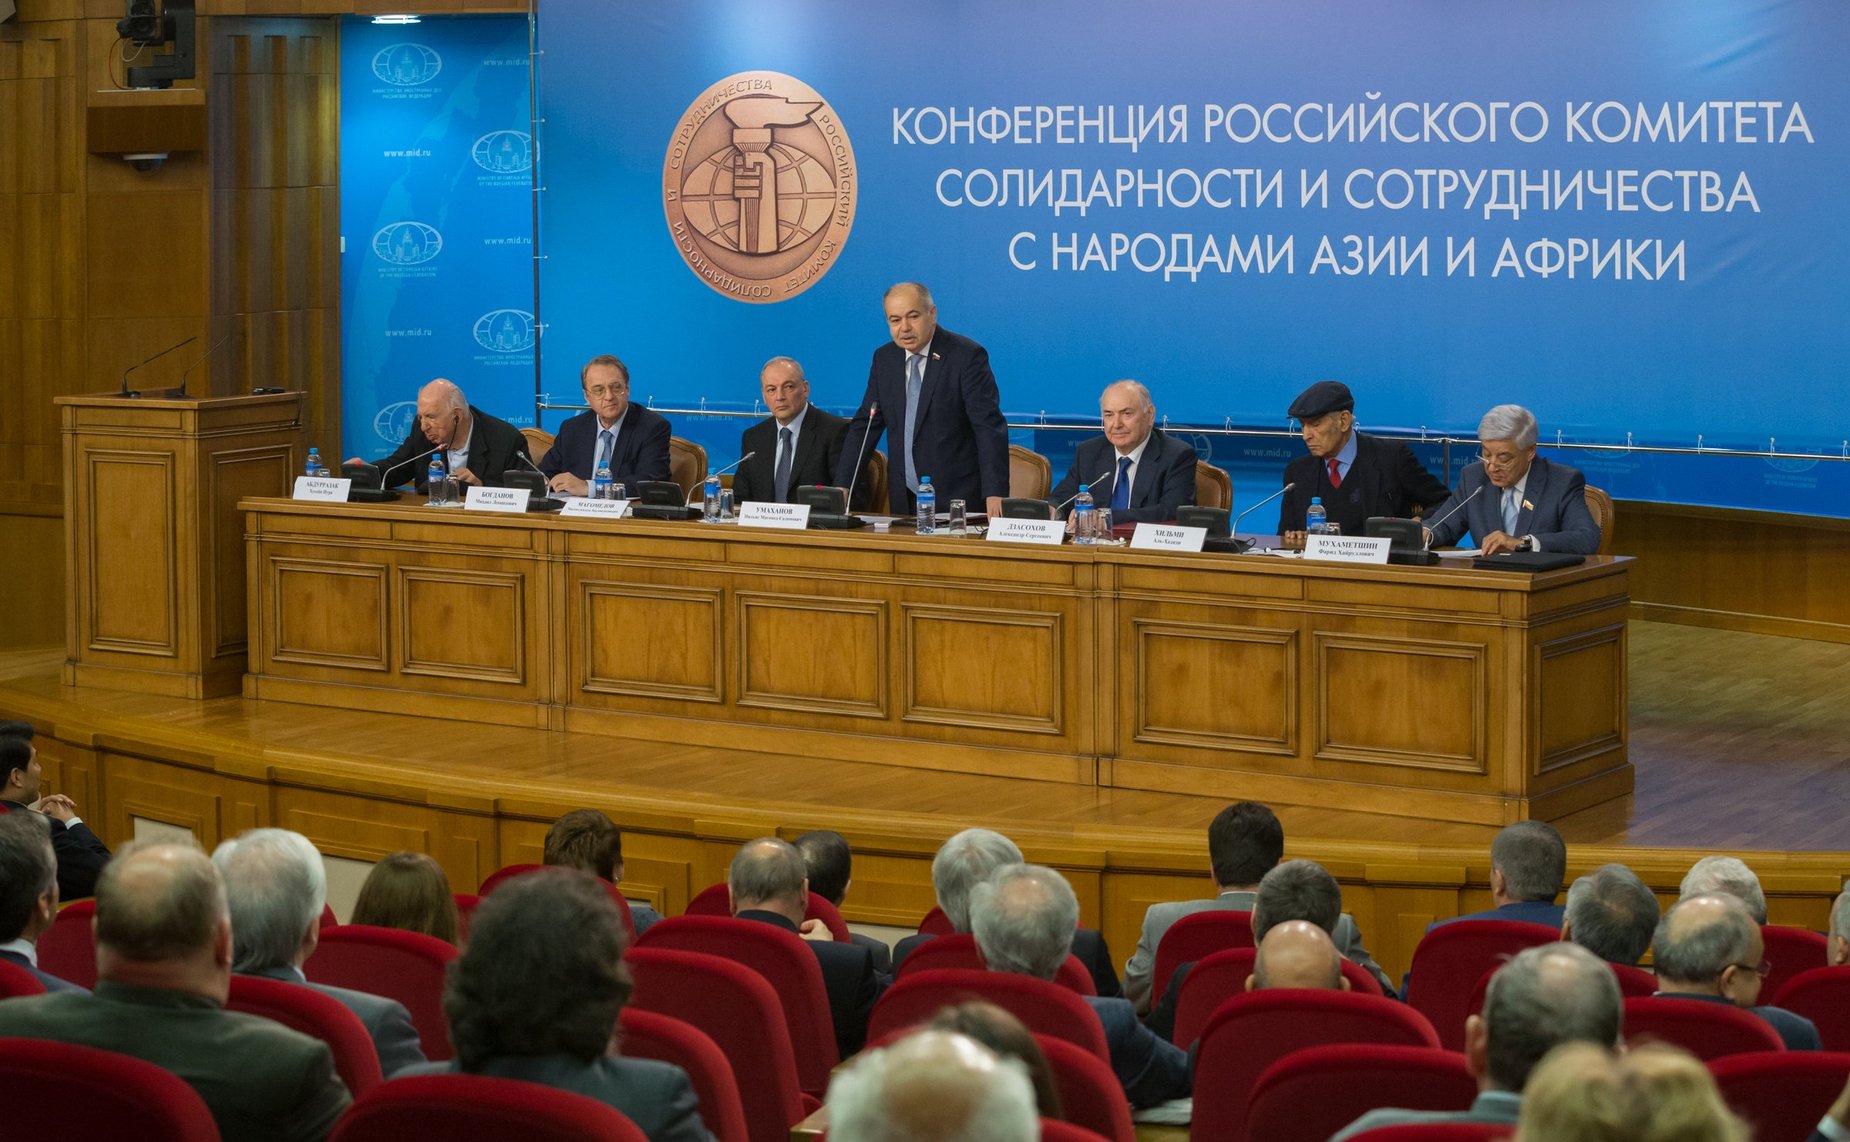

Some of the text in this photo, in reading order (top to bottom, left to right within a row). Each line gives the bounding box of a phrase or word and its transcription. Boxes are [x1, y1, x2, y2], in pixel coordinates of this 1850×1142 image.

[892, 91, 1815, 153] КОНФЕРЕНЦИЯ РОССИЙСКОГО КОМИТЕТА
[383, 148, 431, 158] www.mid.ru
[667, 79, 852, 297] РОССИЙСКИЙ КОМИТЕТ СОЛИДАРНОСТИ И СОТРУДНИЧЕСТВА
[935, 168, 1761, 221] СОЛИДАРНОСТИ И СОТРУДНИЧЕСТВА
[484, 236, 532, 245] www.mid.ru
[1008, 231, 1685, 283] С НАРОДАМИ АЗИИ И АФРИКИ
[384, 328, 432, 337] www.mid.ru
[1243, 447, 1293, 458] www.mid.ru
[481, 491, 514, 499] БОГДАНОВ
[756, 507, 793, 515] УМАХАНОВ
[1007, 523, 1046, 532] ДЗАСОХОВ
[1155, 529, 1185, 538] ХИЛЬМИ
[1318, 540, 1379, 550] МУХАМЕТШИН
